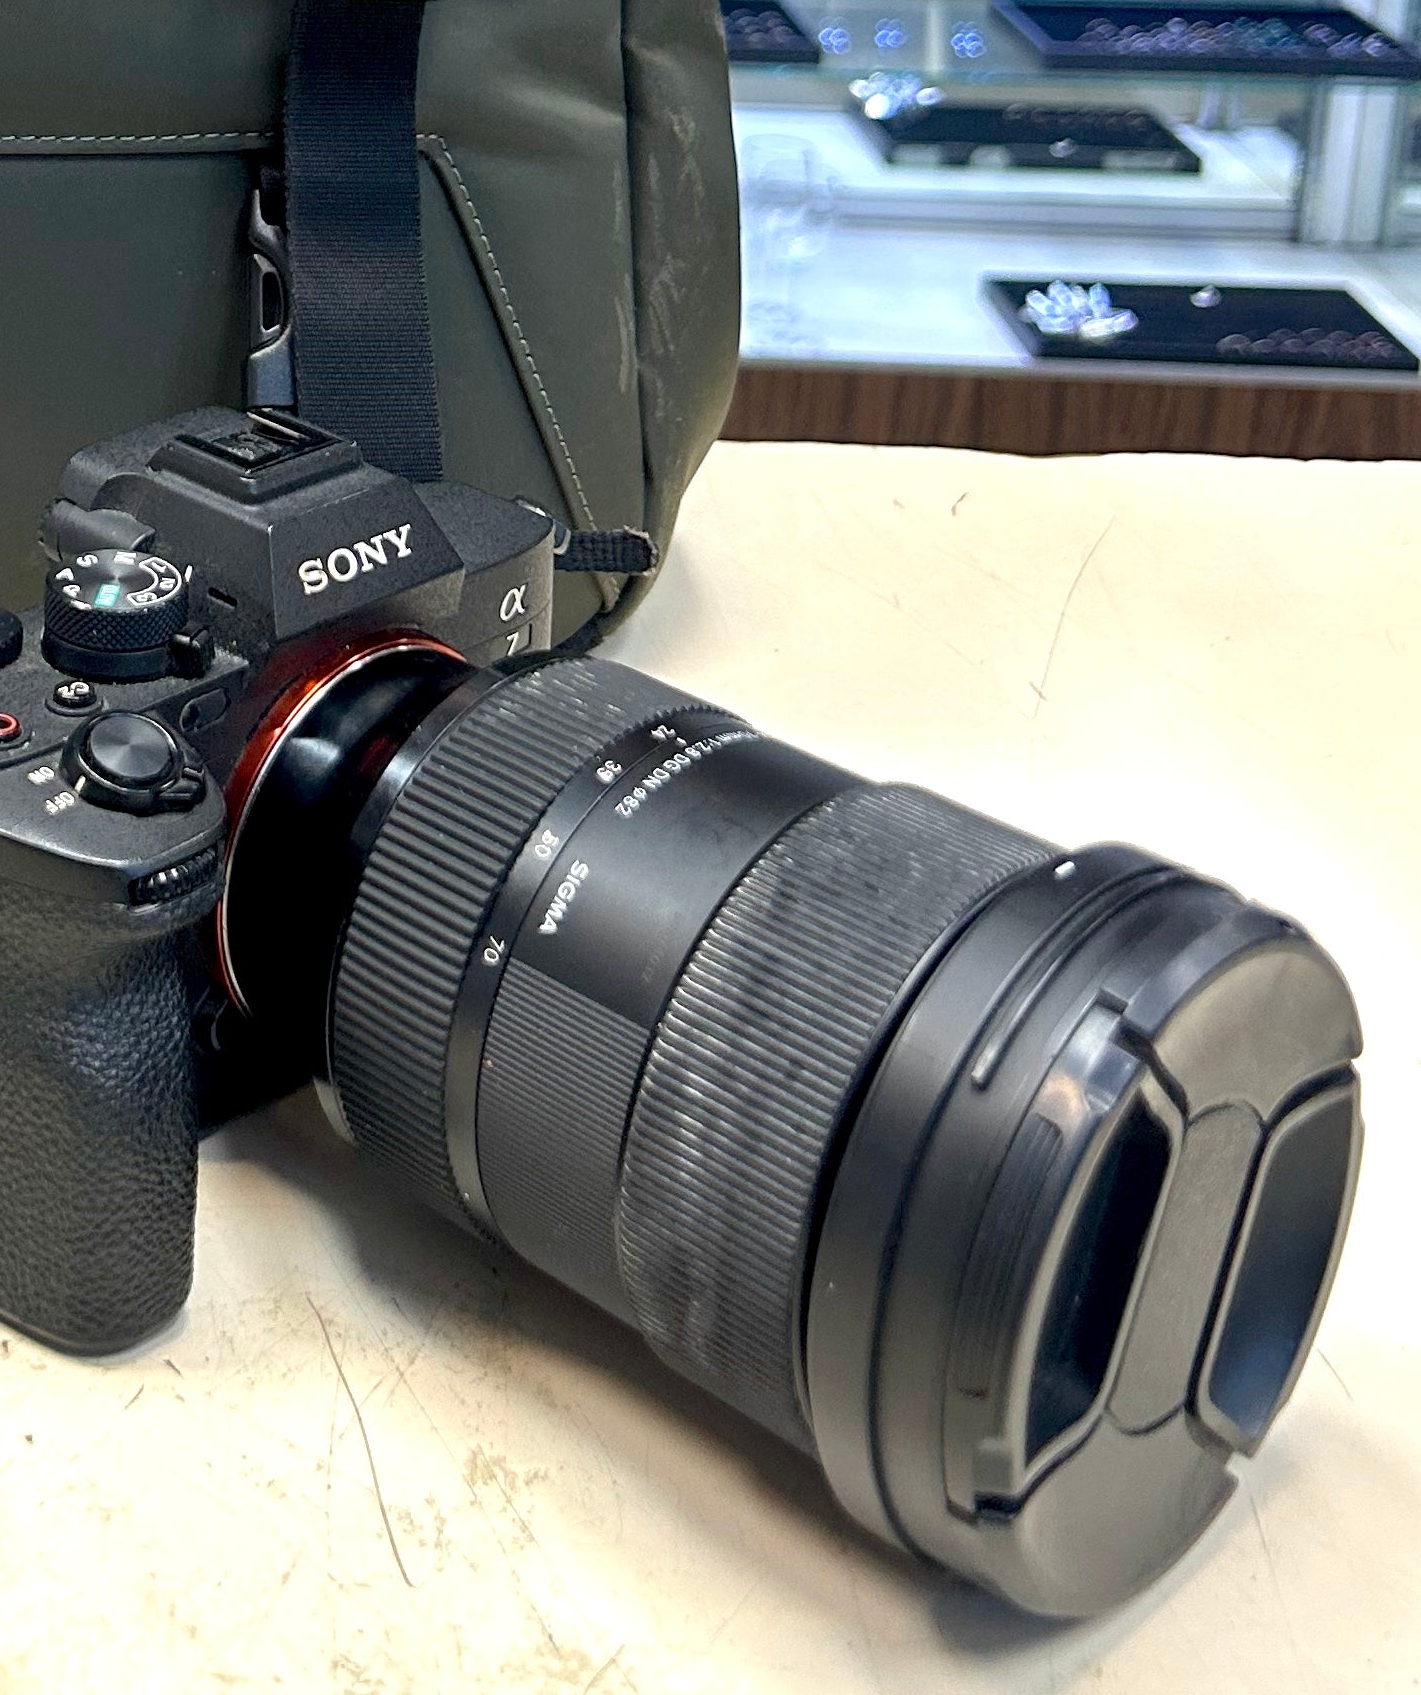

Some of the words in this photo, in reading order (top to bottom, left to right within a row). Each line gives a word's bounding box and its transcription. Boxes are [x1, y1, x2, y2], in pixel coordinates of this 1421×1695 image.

[76, 554, 99, 567] S
[298, 523, 412, 596] SONY
[499, 584, 526, 622] α
[27, 766, 55, 785] ON
[662, 753, 691, 774] DG
[641, 767, 671, 792] DN
[44, 791, 75, 816] OFF
[538, 859, 590, 934] SIGMA
[483, 935, 505, 964] 70
